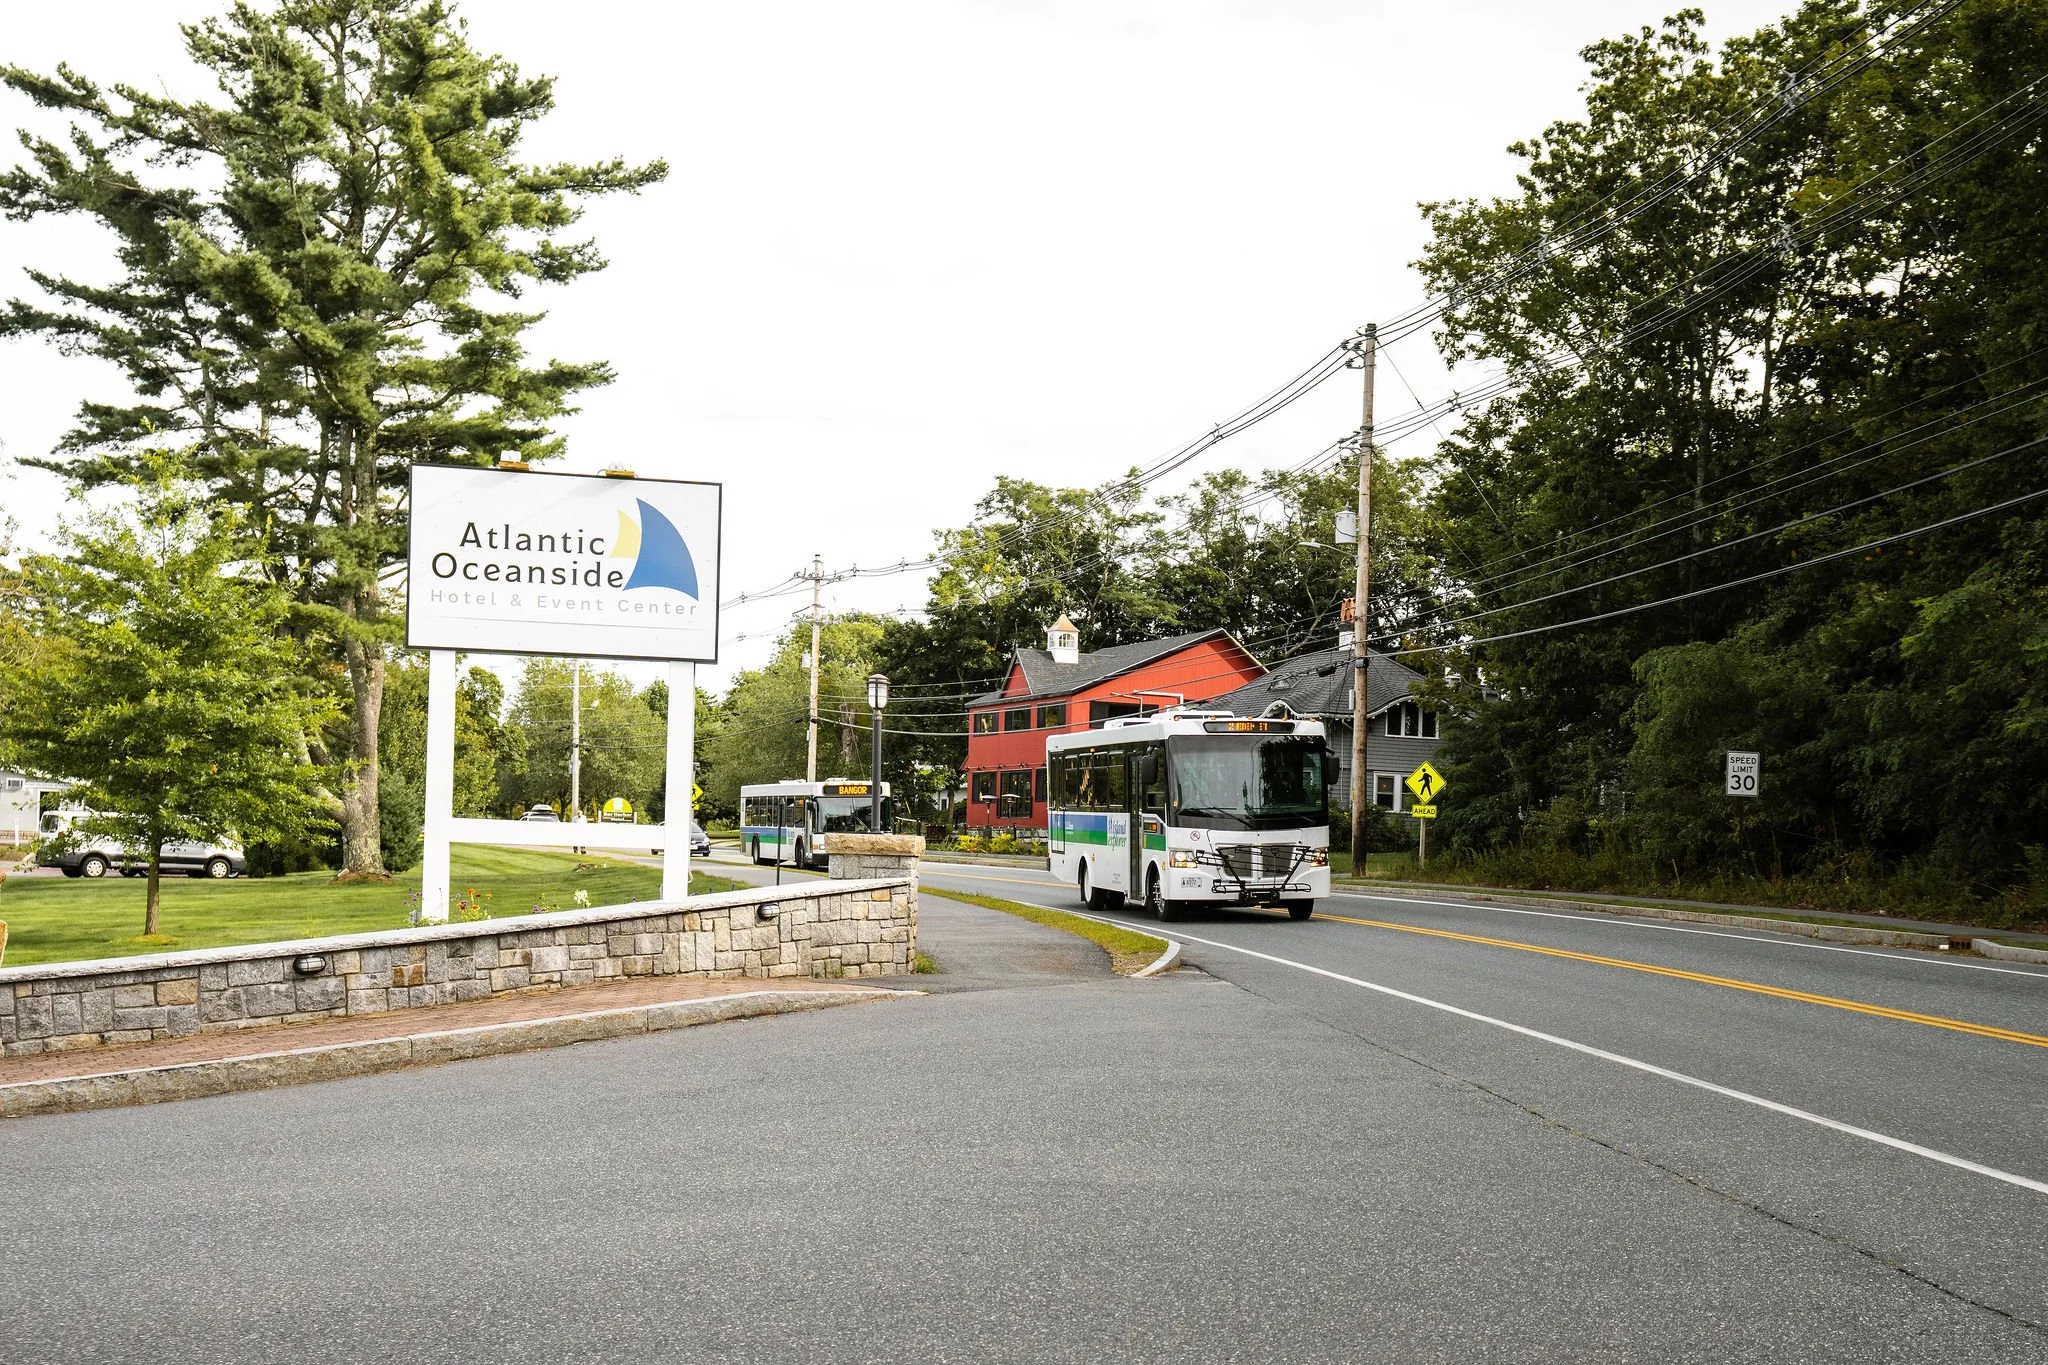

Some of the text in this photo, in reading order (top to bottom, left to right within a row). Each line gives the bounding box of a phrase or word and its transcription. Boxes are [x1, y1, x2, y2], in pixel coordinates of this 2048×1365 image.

[459, 522, 605, 556] Atlantic
[431, 552, 624, 589] Oceanside
[431, 589, 697, 616] Hotel & Event Center
[1730, 756, 1757, 765] SPEED
[838, 786, 868, 795] BANGOR
[1730, 775, 1755, 790] 30
